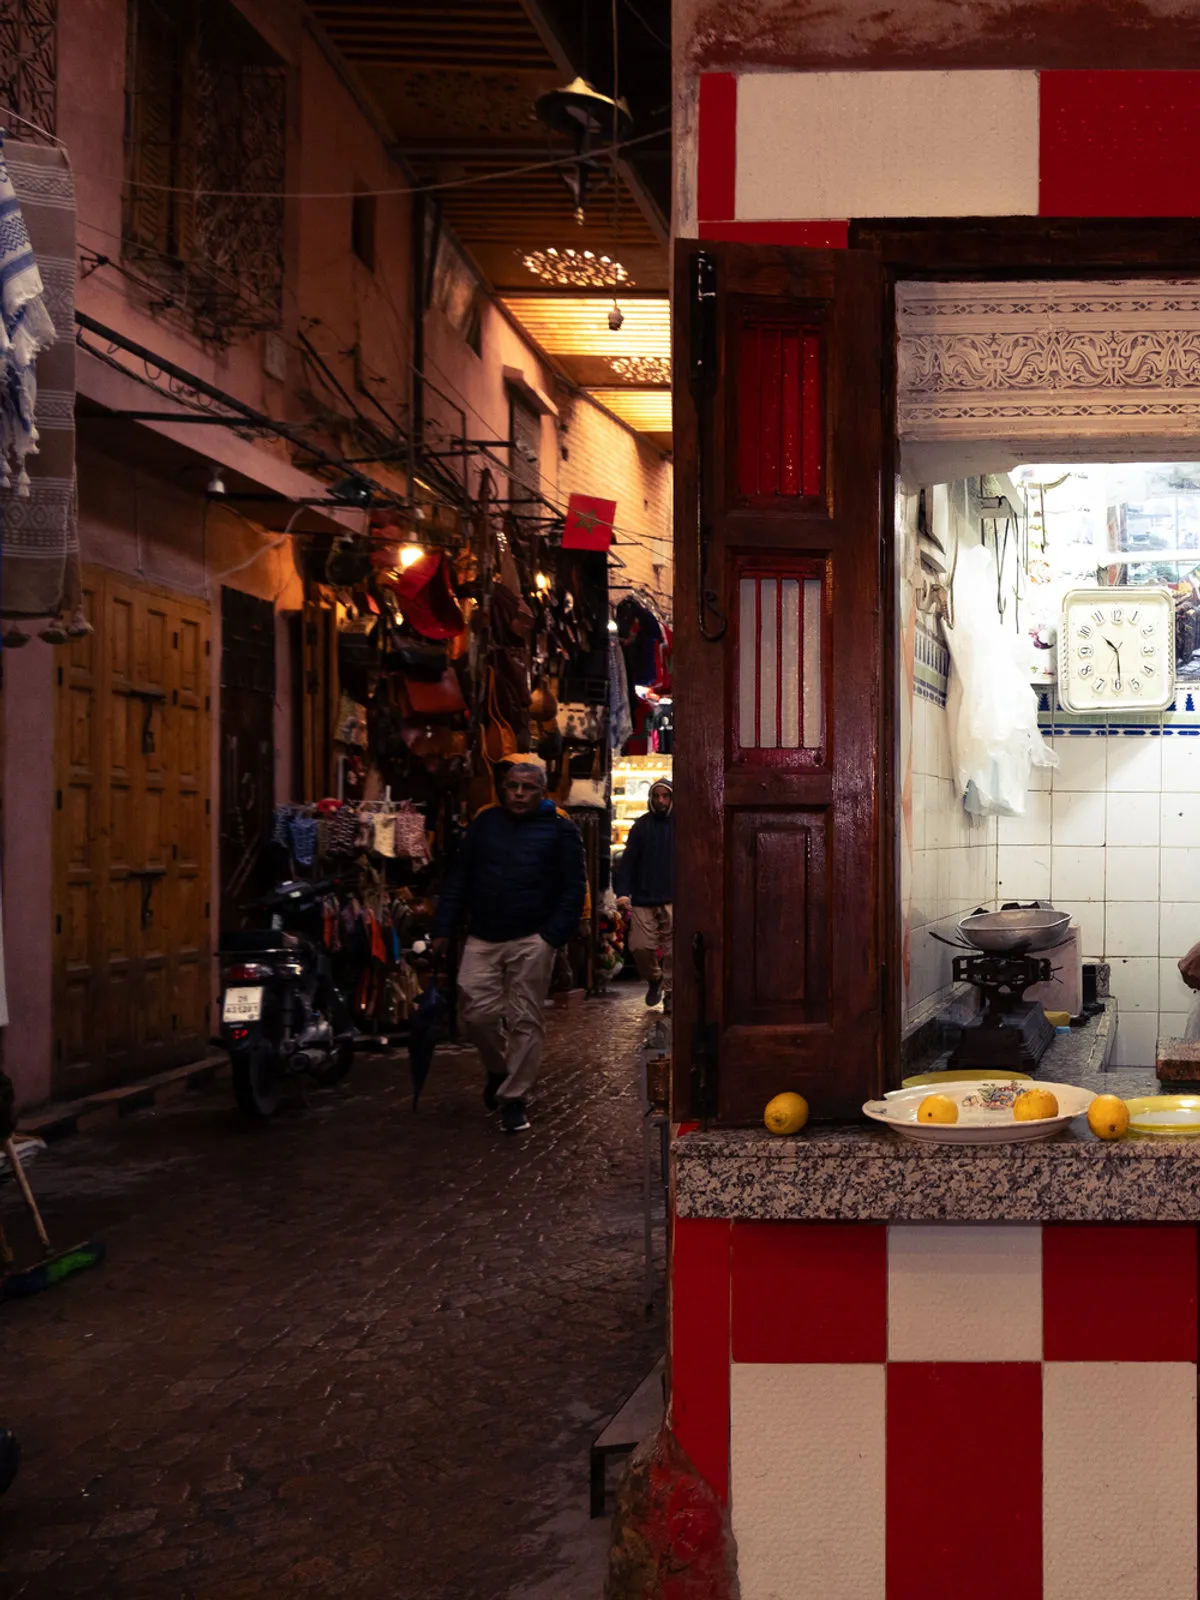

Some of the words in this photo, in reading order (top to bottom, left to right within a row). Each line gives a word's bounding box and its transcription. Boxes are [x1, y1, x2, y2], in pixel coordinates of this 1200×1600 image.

[1094, 610, 1105, 622] 11
[1113, 610, 1122, 622] 12
[1080, 625, 1092, 637] 10
[1143, 625, 1154, 636] 2
[1080, 646, 1092, 655] 9
[1144, 646, 1154, 655] 3
[1081, 665, 1092, 676] 8
[1144, 665, 1154, 674] 4
[1096, 678, 1105, 690] 7
[1114, 679, 1122, 690] 6
[1131, 678, 1140, 690] 5
